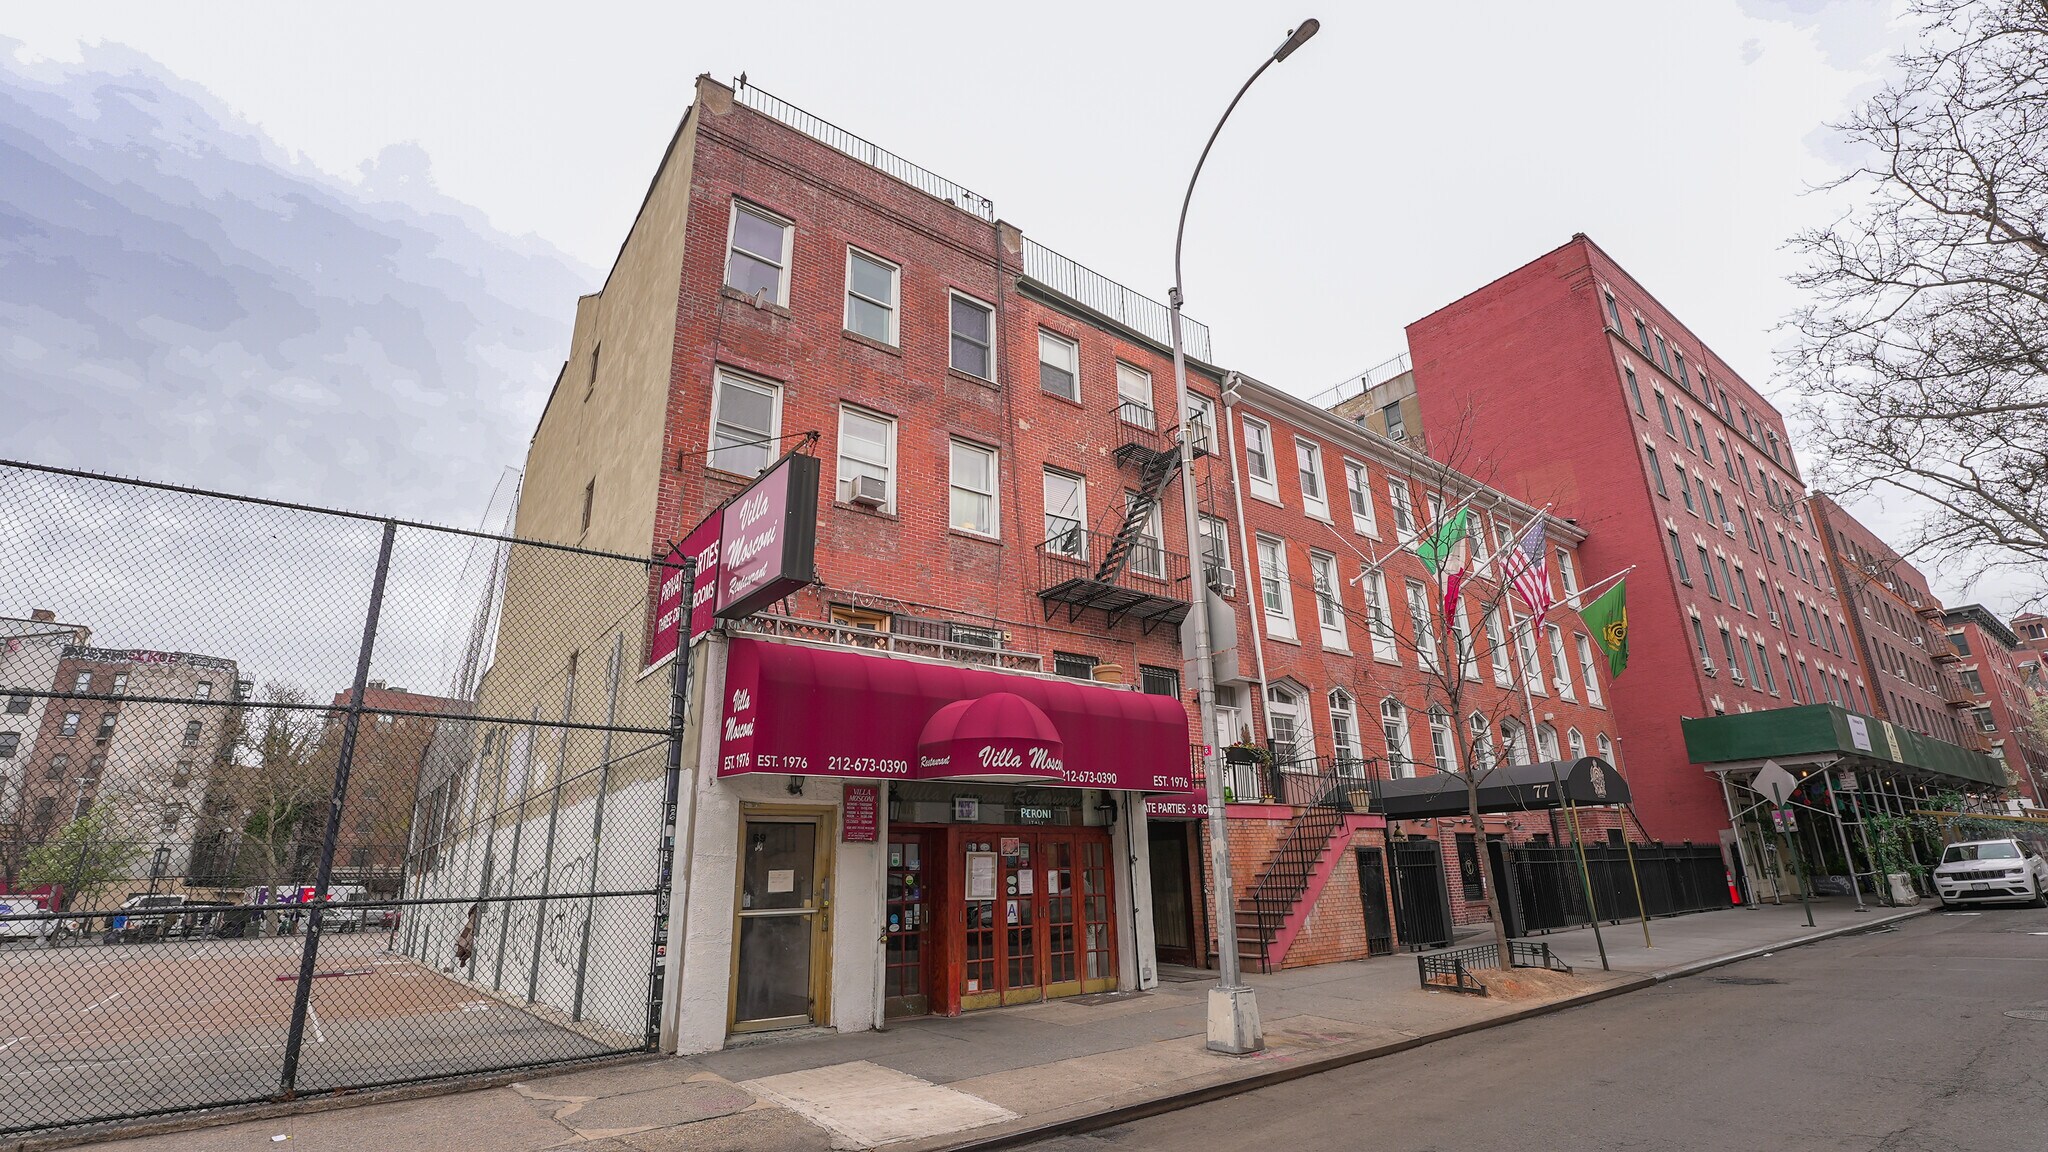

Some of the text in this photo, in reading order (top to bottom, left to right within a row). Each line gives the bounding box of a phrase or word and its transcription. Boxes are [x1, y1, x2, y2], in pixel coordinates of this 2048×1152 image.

[739, 490, 770, 531] Villa
[727, 519, 778, 571] Mosconi
[660, 538, 720, 606] PRIVAT ARTIES
[728, 561, 769, 598] Restaurant
[692, 579, 716, 609] ROOMS
[732, 688, 751, 713] Villa
[724, 716, 755, 742] Mosconi
[723, 752, 750, 771] EST. 1976
[757, 754, 908, 774] EST. 1976 212-673-0390
[920, 754, 951, 768] Restaurant
[978, 745, 1065, 772] Villa Mosco
[1153, 775, 1189, 788] EST. 1976
[1532, 784, 1550, 799] 77
[853, 788, 871, 796] VILLA
[1020, 807, 1052, 819] PERONI
[1157, 802, 1187, 815] PARTIES
[1191, 804, 1197, 815] 3
[1007, 903, 1017, 917] A
